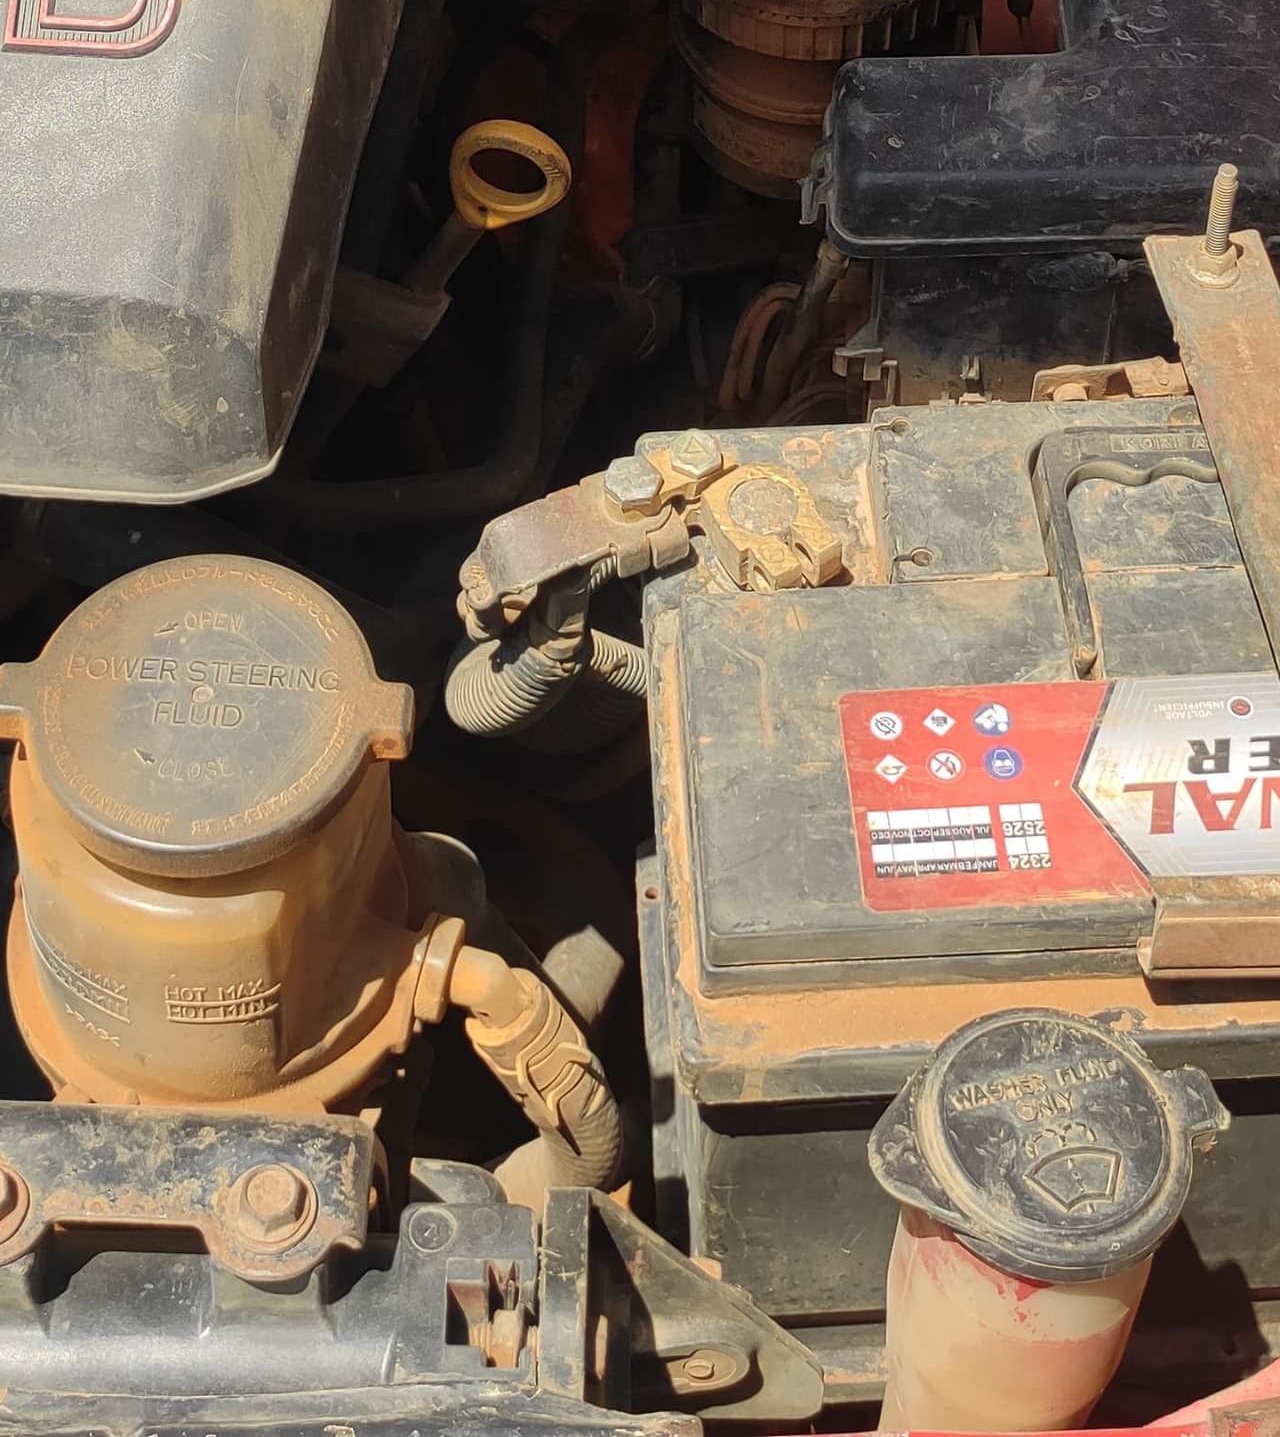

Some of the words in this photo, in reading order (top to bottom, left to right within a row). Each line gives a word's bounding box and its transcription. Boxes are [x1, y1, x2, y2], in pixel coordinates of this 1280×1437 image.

[184, 611, 243, 633] OPEN
[67, 653, 178, 681] POWER
[188, 660, 340, 692] STEERING
[153, 701, 243, 729] FLUID
[1165, 708, 1213, 720] VOLTAGE
[165, 986, 207, 1002] HOT
[218, 978, 263, 1001] MAX
[167, 1003, 208, 1019] HOT
[949, 1074, 1048, 1111] WASHER
[1055, 1058, 1121, 1086] FLUID
[1016, 1091, 1074, 1122] ONLY
